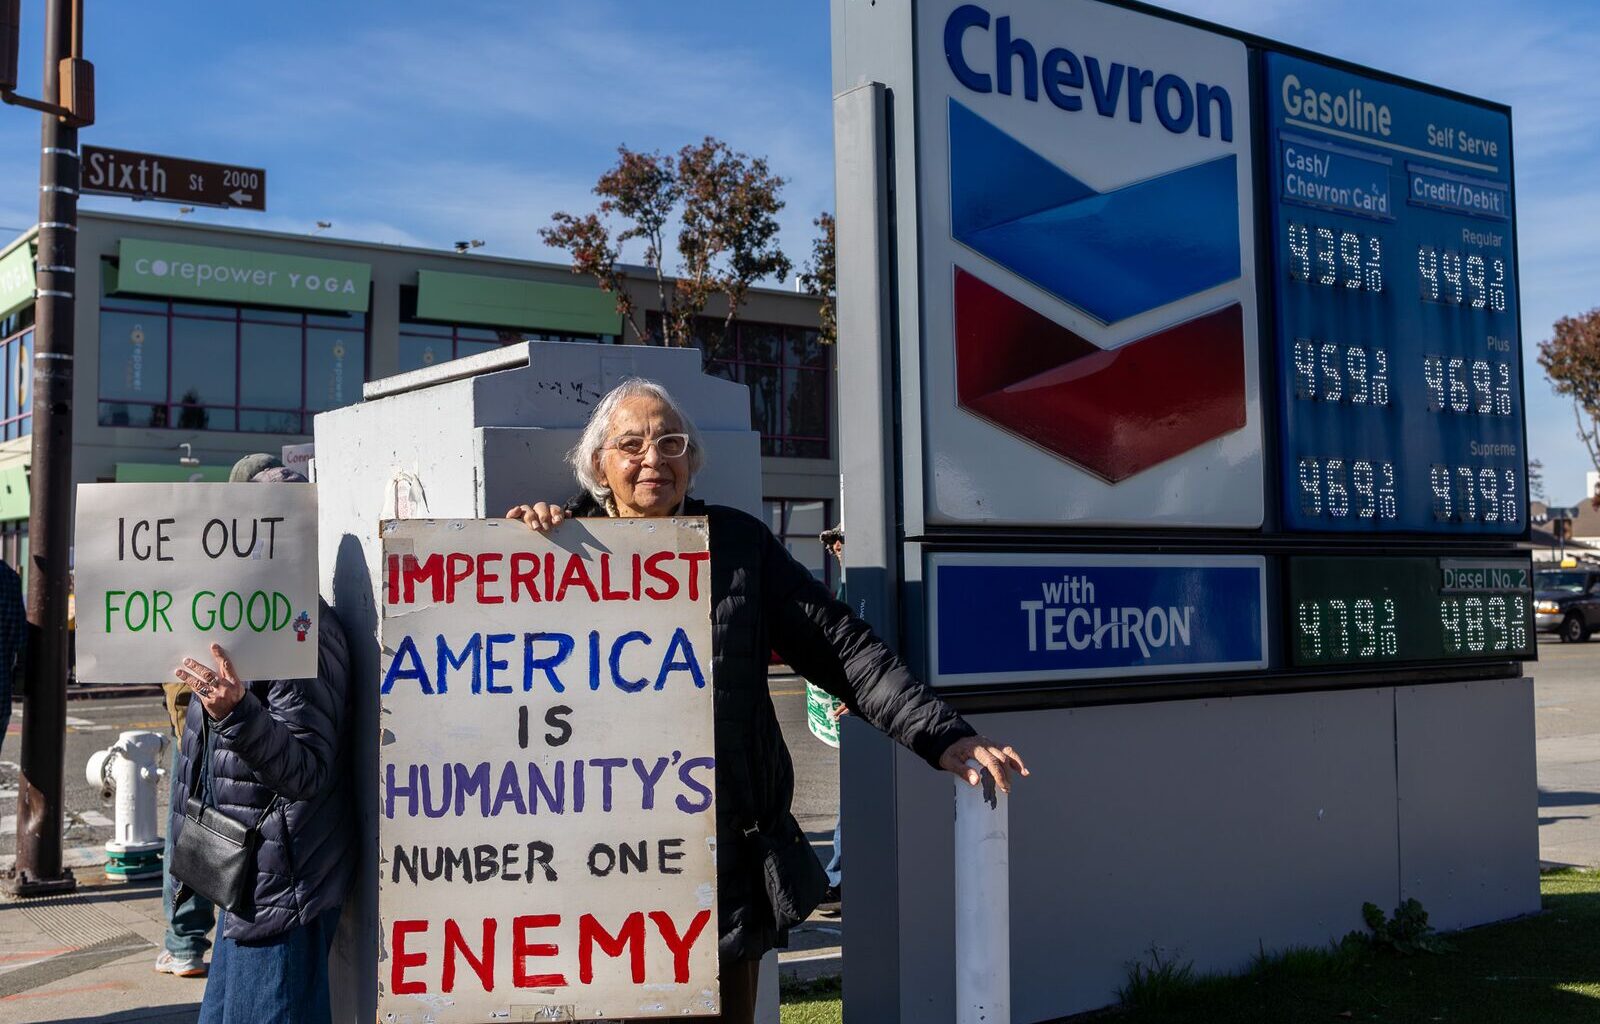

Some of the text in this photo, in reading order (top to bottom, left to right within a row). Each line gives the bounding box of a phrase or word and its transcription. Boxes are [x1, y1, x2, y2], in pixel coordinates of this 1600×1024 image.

[944, 4, 1233, 143] Chevron
[1282, 74, 1391, 136] Gasoline
[1427, 124, 1498, 158] Self Serve
[89, 152, 258, 193] Sixth St 2000
[1286, 148, 1330, 178] Cash/
[1286, 174, 1387, 213] Chevron Card
[1413, 177, 1500, 212] Credit/Debit
[1462, 228, 1503, 249] Regular
[135, 258, 356, 294] corepower YOGA
[1487, 336, 1510, 352] Plus
[1470, 440, 1516, 457] Supreme
[118, 517, 284, 561] ICE OUT
[387, 551, 710, 604] IMPERIALIST
[1042, 575, 1095, 604] with
[1443, 568, 1527, 589] Diesel No. 2
[105, 590, 292, 633] FOR GOOD
[1020, 600, 1191, 658] TECHRON
[381, 627, 706, 695] AMERICA
[518, 705, 573, 749] IS
[386, 751, 715, 819] HUMANITY'S
[392, 838, 686, 886] NUMBER ONE
[391, 910, 711, 995] ENEMY
